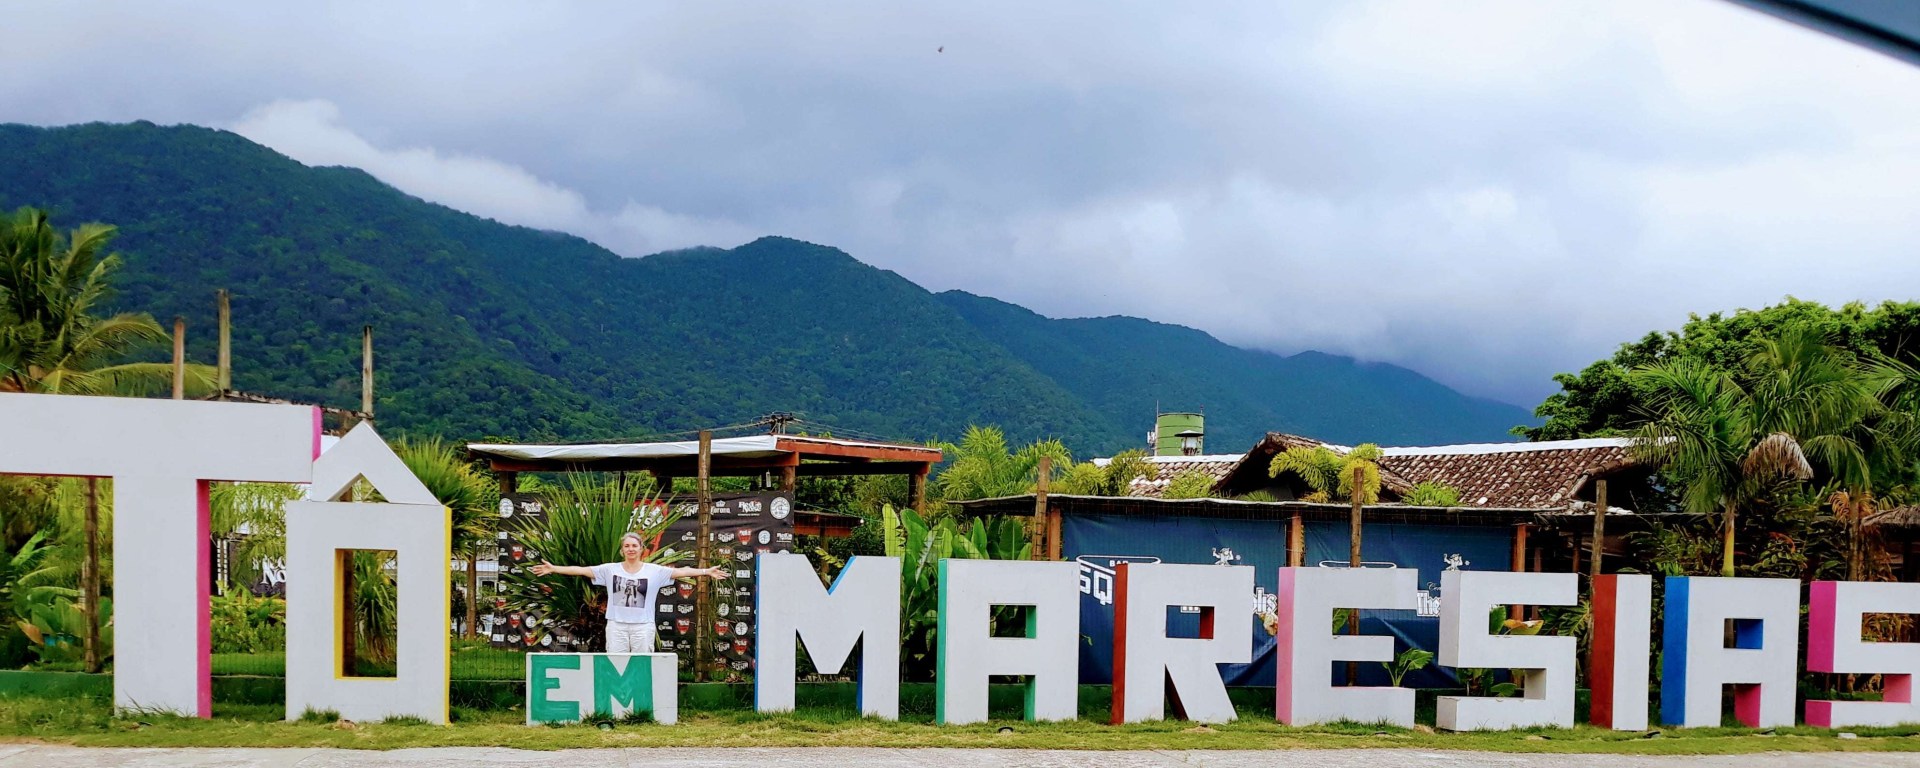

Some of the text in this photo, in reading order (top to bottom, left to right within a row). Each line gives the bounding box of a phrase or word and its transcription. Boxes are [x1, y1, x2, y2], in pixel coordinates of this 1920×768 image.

[0, 393, 1920, 734] TÔ EM MARESIAS
